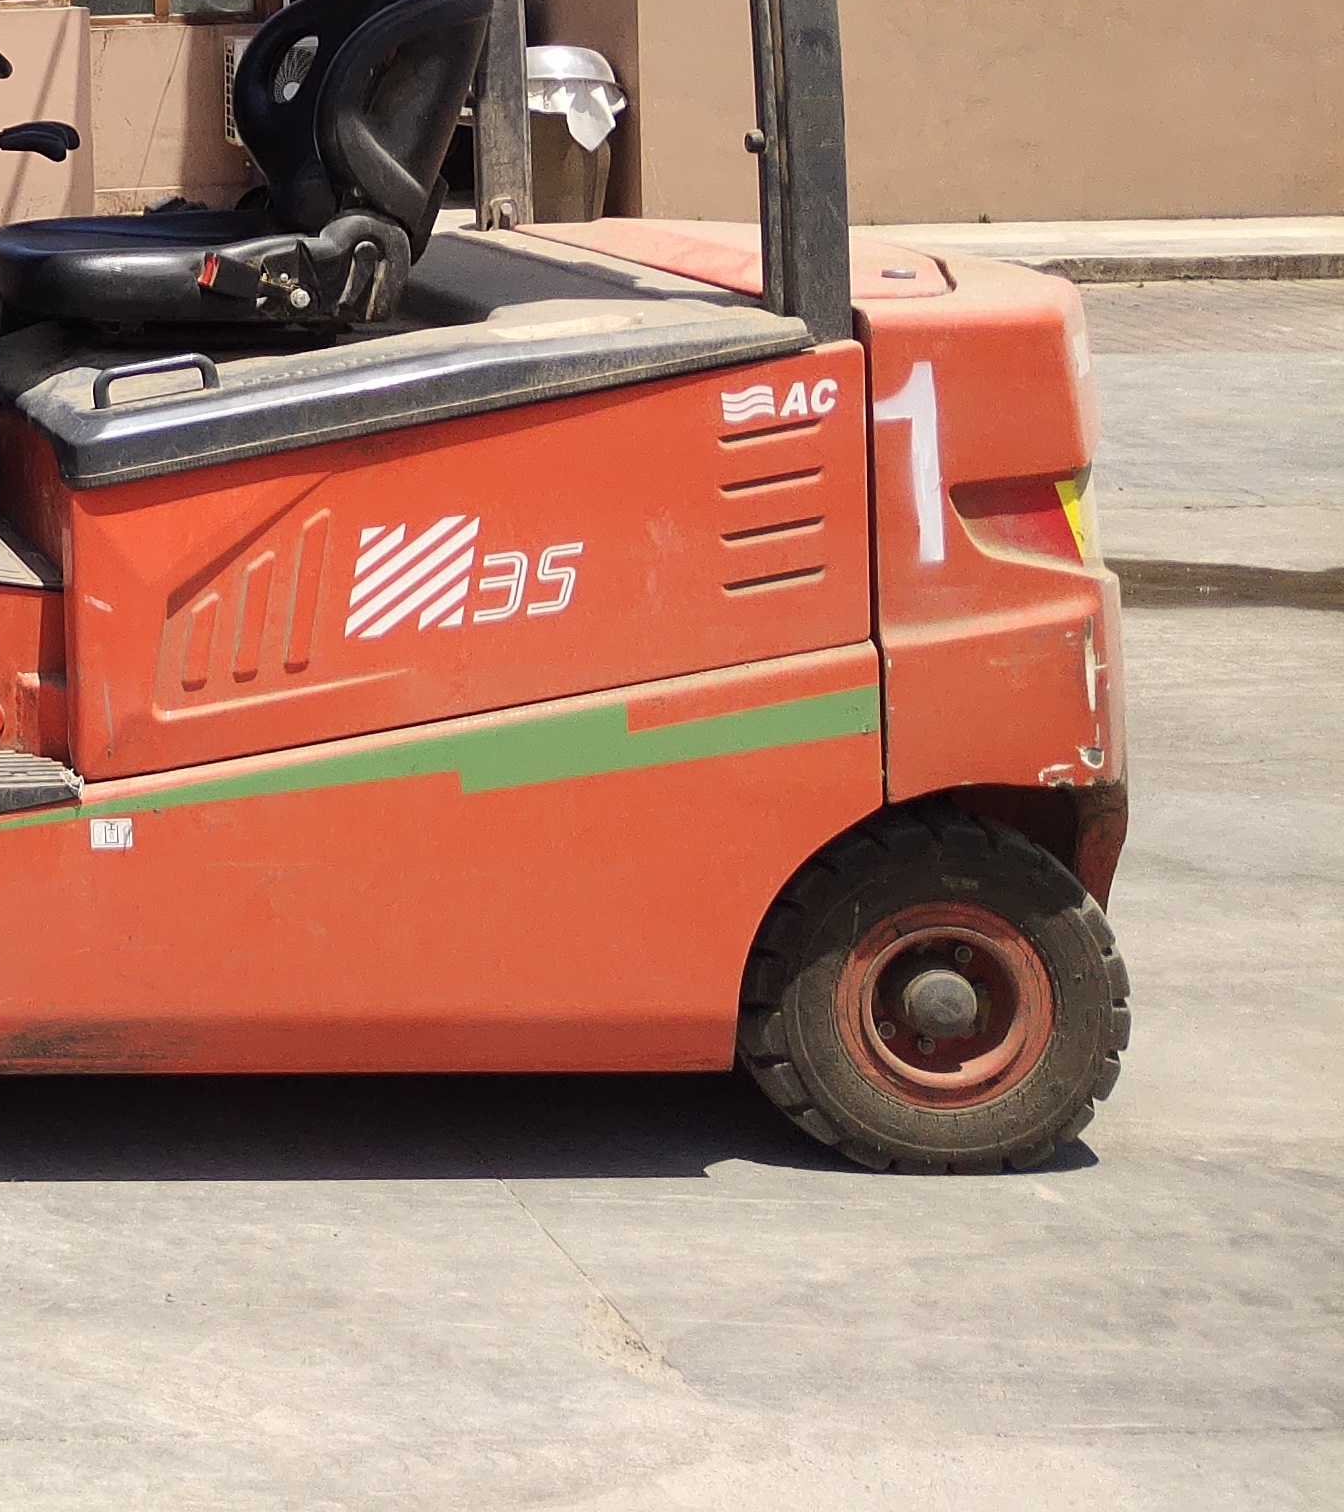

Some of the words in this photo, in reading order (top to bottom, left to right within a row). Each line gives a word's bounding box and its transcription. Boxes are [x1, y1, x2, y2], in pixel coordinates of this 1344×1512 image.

[779, 379, 838, 417] AC
[873, 361, 944, 562] 1
[473, 541, 584, 623] 35
